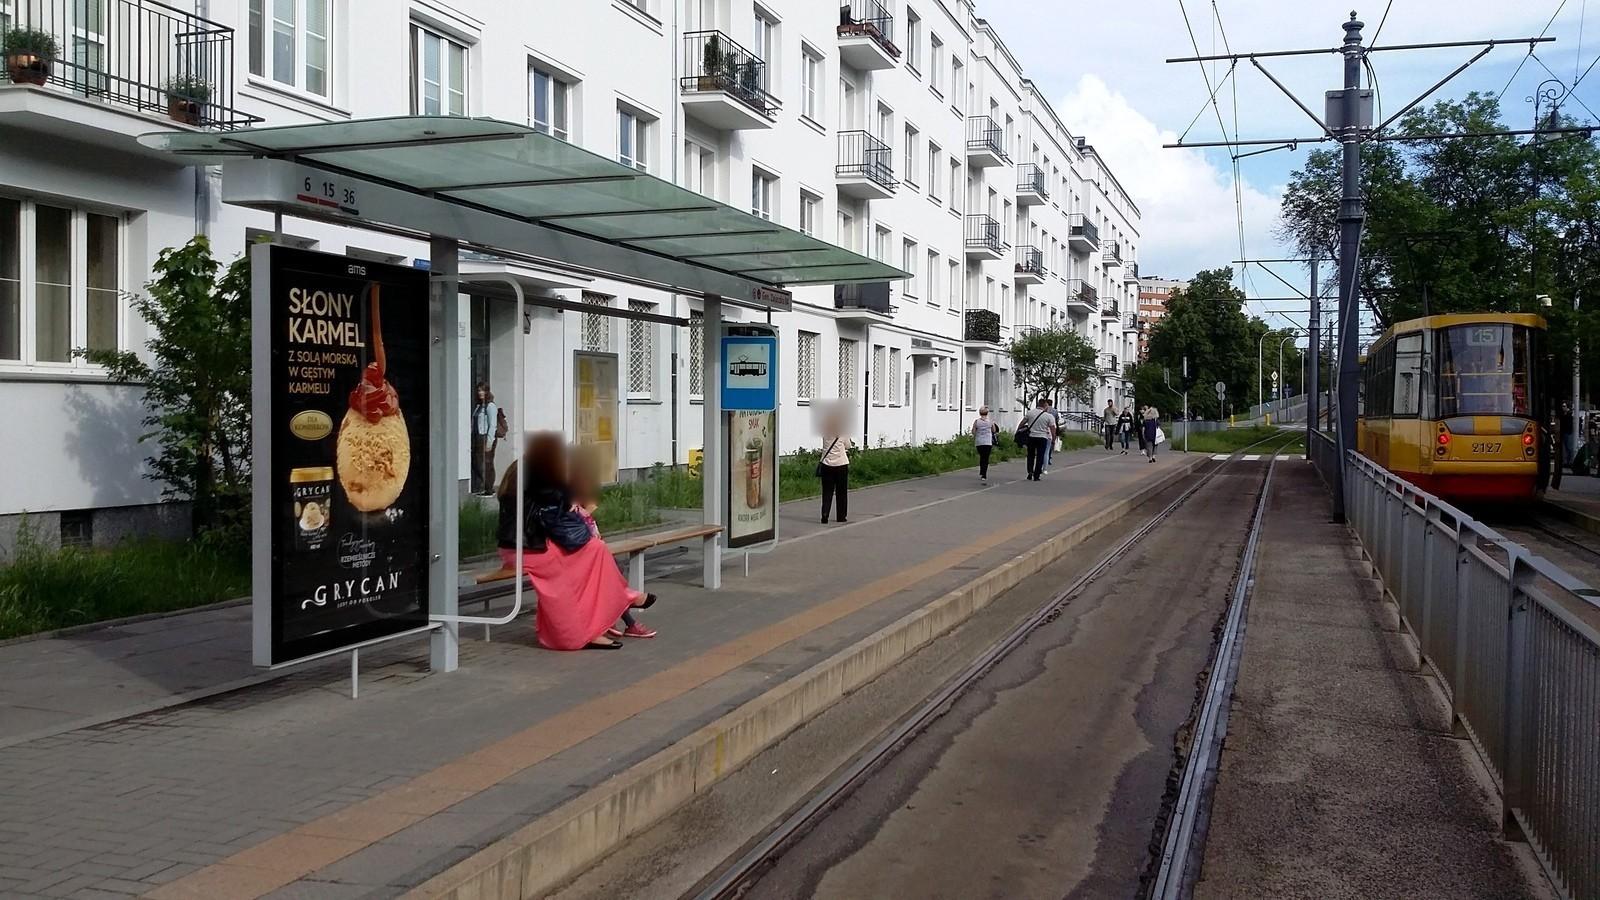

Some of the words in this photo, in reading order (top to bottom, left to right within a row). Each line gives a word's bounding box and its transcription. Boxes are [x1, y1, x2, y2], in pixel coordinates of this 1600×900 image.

[304, 177, 311, 192] 6
[322, 182, 335, 198] 15
[343, 188, 355, 205] 36
[347, 264, 367, 276] ams
[288, 287, 354, 319] SŁONY
[289, 317, 366, 348] KARMEL
[1474, 329, 1495, 342] 15
[288, 350, 295, 362] Z
[297, 351, 321, 365] SOLĄ
[322, 352, 358, 367] MORSKĄ
[288, 367, 299, 378] W
[301, 366, 336, 381] GĘSTYM
[288, 382, 330, 395] KARMELU
[1472, 442, 1502, 454] 2127
[302, 571, 399, 610] GRYCAN
